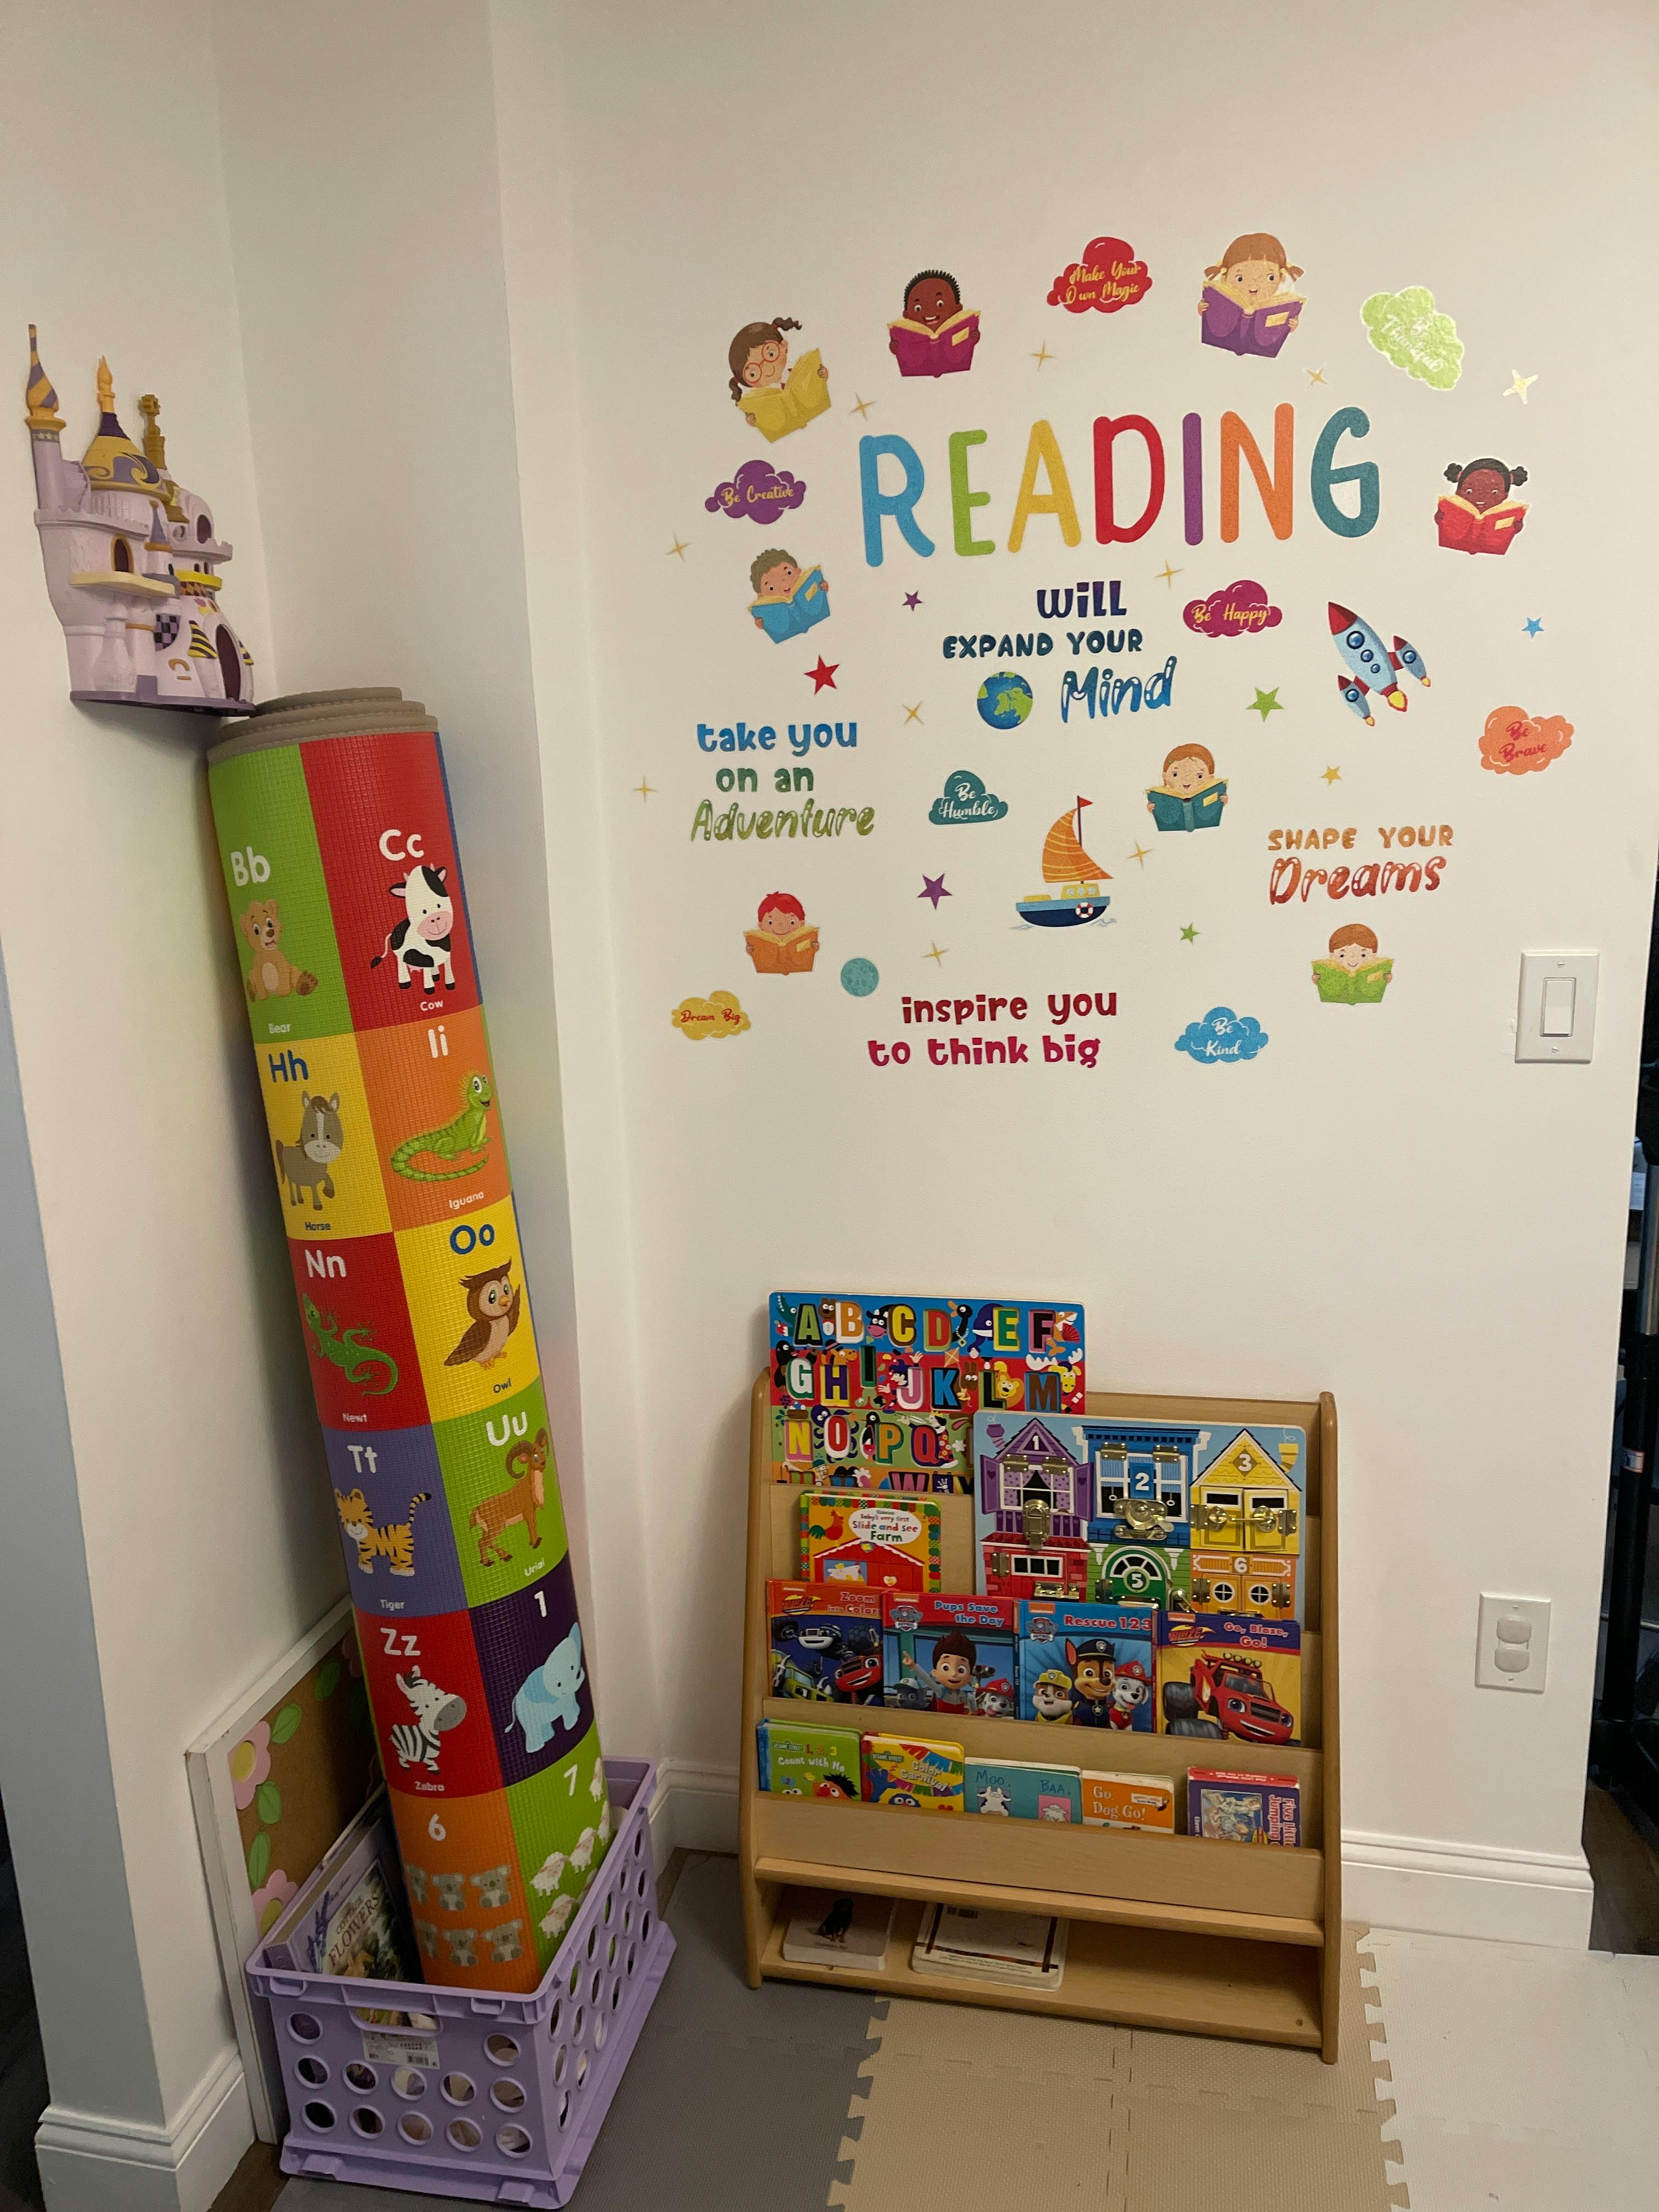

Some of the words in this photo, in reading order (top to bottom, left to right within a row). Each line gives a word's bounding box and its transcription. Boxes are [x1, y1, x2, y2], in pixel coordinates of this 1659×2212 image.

[1069, 265, 1105, 285] Make
[1111, 261, 1141, 280] Your
[1102, 281, 1140, 302] Magic
[721, 487, 741, 506] Be
[746, 485, 794, 503] Creative
[859, 403, 1379, 567] READING
[1191, 603, 1211, 624] Be
[1222, 602, 1268, 627] Happy
[943, 632, 1054, 658] EXPAND
[1066, 628, 1143, 655] YOUR
[1060, 656, 1178, 723] Mind
[697, 722, 777, 753] take
[787, 722, 858, 757] you
[1505, 721, 1529, 741] Be
[1499, 742, 1548, 763] Brave
[715, 767, 758, 793] on
[774, 767, 815, 793] an
[955, 782, 975, 802] Be
[690, 798, 875, 842] Adventure
[379, 829, 425, 861] Cc
[1267, 828, 1358, 851] SHAPE
[1378, 825, 1453, 848] YOUR
[230, 847, 271, 887] Bb
[1269, 856, 1447, 905] Dreams
[420, 1000, 444, 1012] Cow
[680, 1009, 715, 1023] Dream
[721, 1008, 741, 1025] Big
[901, 995, 1028, 1025] inspire
[1047, 992, 1117, 1025] you
[268, 1023, 291, 1034] Bear
[1211, 1017, 1234, 1035] Be
[867, 1040, 911, 1066] to
[927, 1036, 1029, 1066] think
[1042, 1034, 1101, 1069] big
[1206, 1040, 1242, 1056] Kind
[268, 1050, 308, 1082] Hh
[448, 1191, 484, 1210] Iguana
[305, 1222, 331, 1231] Horse
[449, 1224, 495, 1255] Oo
[304, 1250, 347, 1278] Nn
[493, 1379, 511, 1393] Owl
[342, 1413, 367, 1423] Newt
[486, 1411, 528, 1446] Uu
[1033, 1436, 1040, 1450] 1
[347, 1445, 377, 1474] Tt
[1239, 1454, 1251, 1472] 3
[1136, 1473, 1150, 1491] 2
[853, 1521, 877, 1529] Slide
[871, 1531, 902, 1542] Farm
[524, 1558, 545, 1577] Urial
[1234, 1558, 1247, 1573] 6
[1131, 1573, 1143, 1589] 5
[380, 1599, 405, 1611] Tiger
[534, 1590, 547, 1617] 1
[934, 1600, 963, 1613] Pups
[968, 1602, 998, 1613] Save
[955, 1613, 975, 1624] the
[979, 1615, 1004, 1628] Day
[1064, 1615, 1116, 1628] Rescue
[380, 1628, 421, 1657] Zz
[1240, 1635, 1268, 1648] Go!
[830, 1746, 837, 1756] 3
[778, 1757, 805, 1765] Count
[809, 1758, 829, 1768] with
[832, 1761, 845, 1772] Me
[912, 1761, 941, 1776] Color
[564, 1765, 578, 1796] 7
[900, 1769, 949, 1791] Carnival
[1122, 1805, 1146, 1821] Go!
[1268, 1795, 1281, 1841] Jumping
[1282, 1797, 1296, 1821] Five
[428, 1814, 446, 1841] 6
